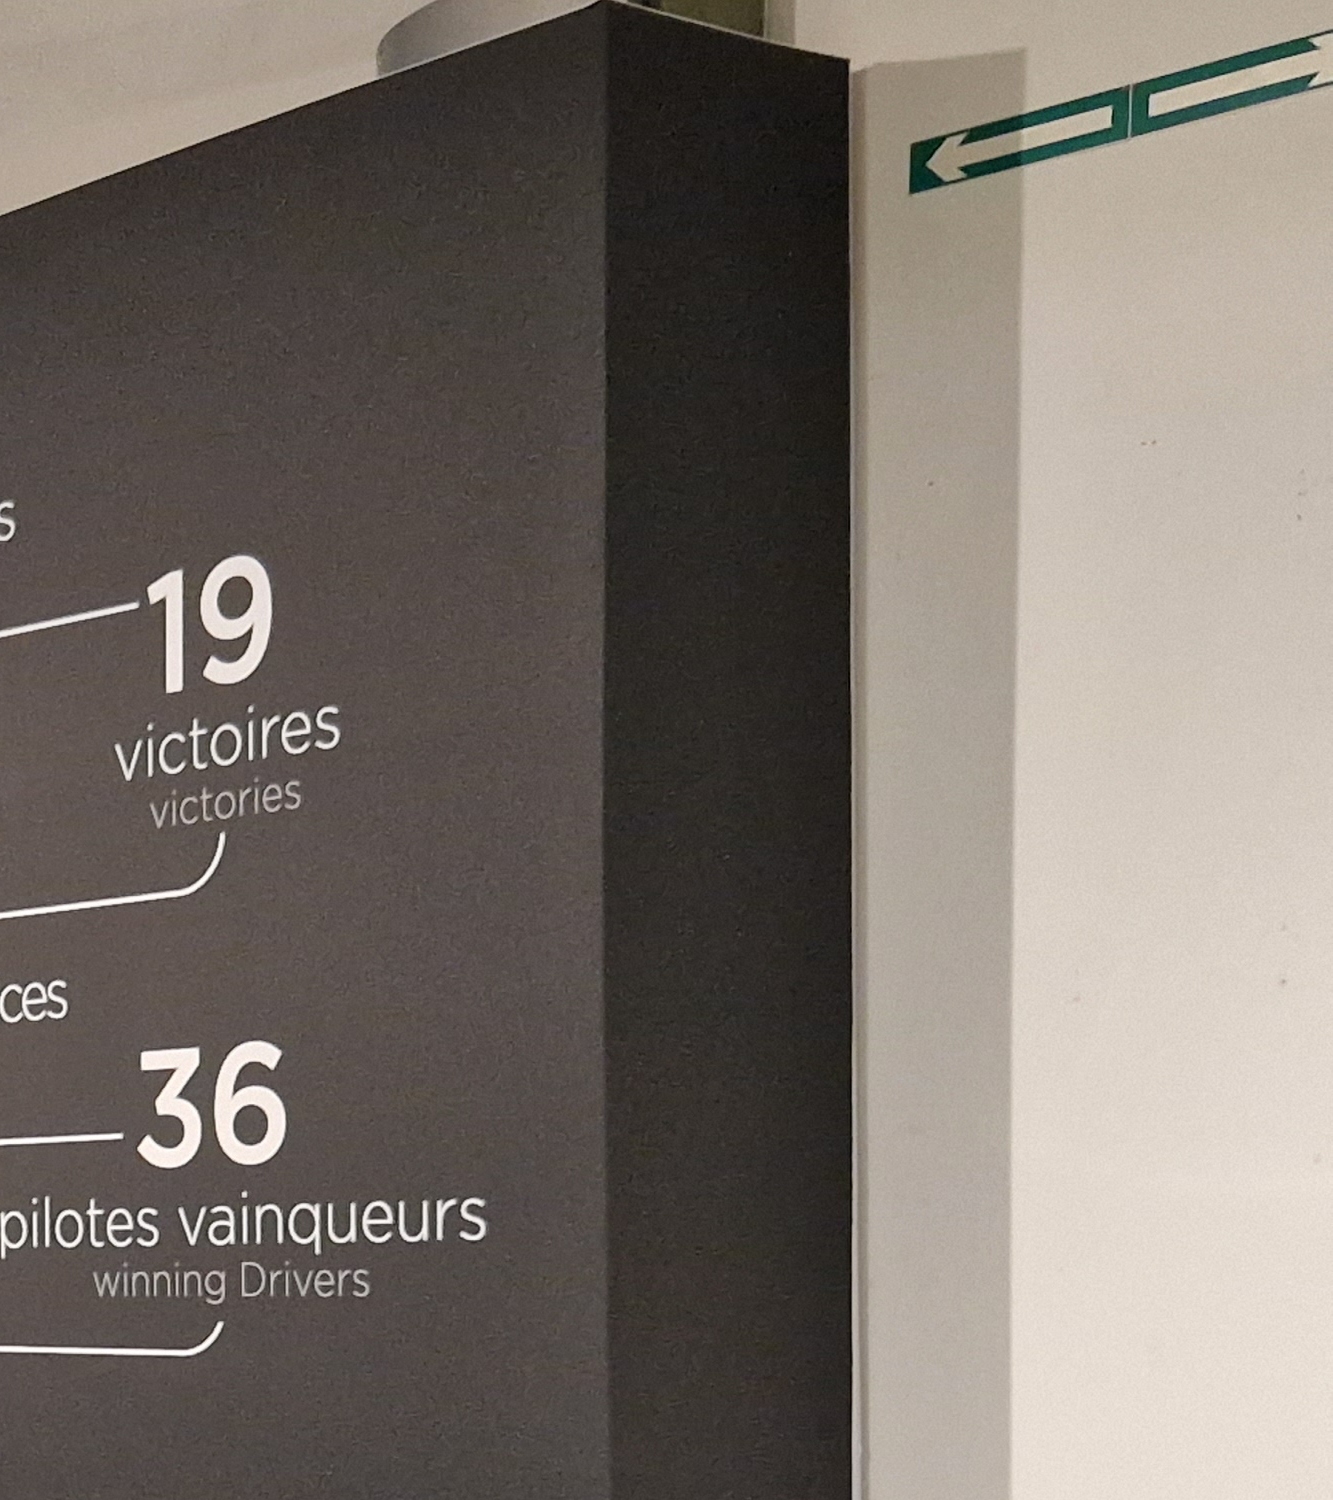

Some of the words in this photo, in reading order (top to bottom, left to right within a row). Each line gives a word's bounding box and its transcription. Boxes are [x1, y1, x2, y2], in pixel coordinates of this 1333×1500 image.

[148, 556, 272, 693] 19
[115, 706, 340, 781] victoires
[150, 781, 301, 828] victories
[138, 1041, 286, 1168] 36
[0, 1196, 159, 1259] pilotes
[178, 1191, 486, 1255] vainqueurs
[93, 1265, 225, 1304] winning
[242, 1262, 369, 1297] Drivers
